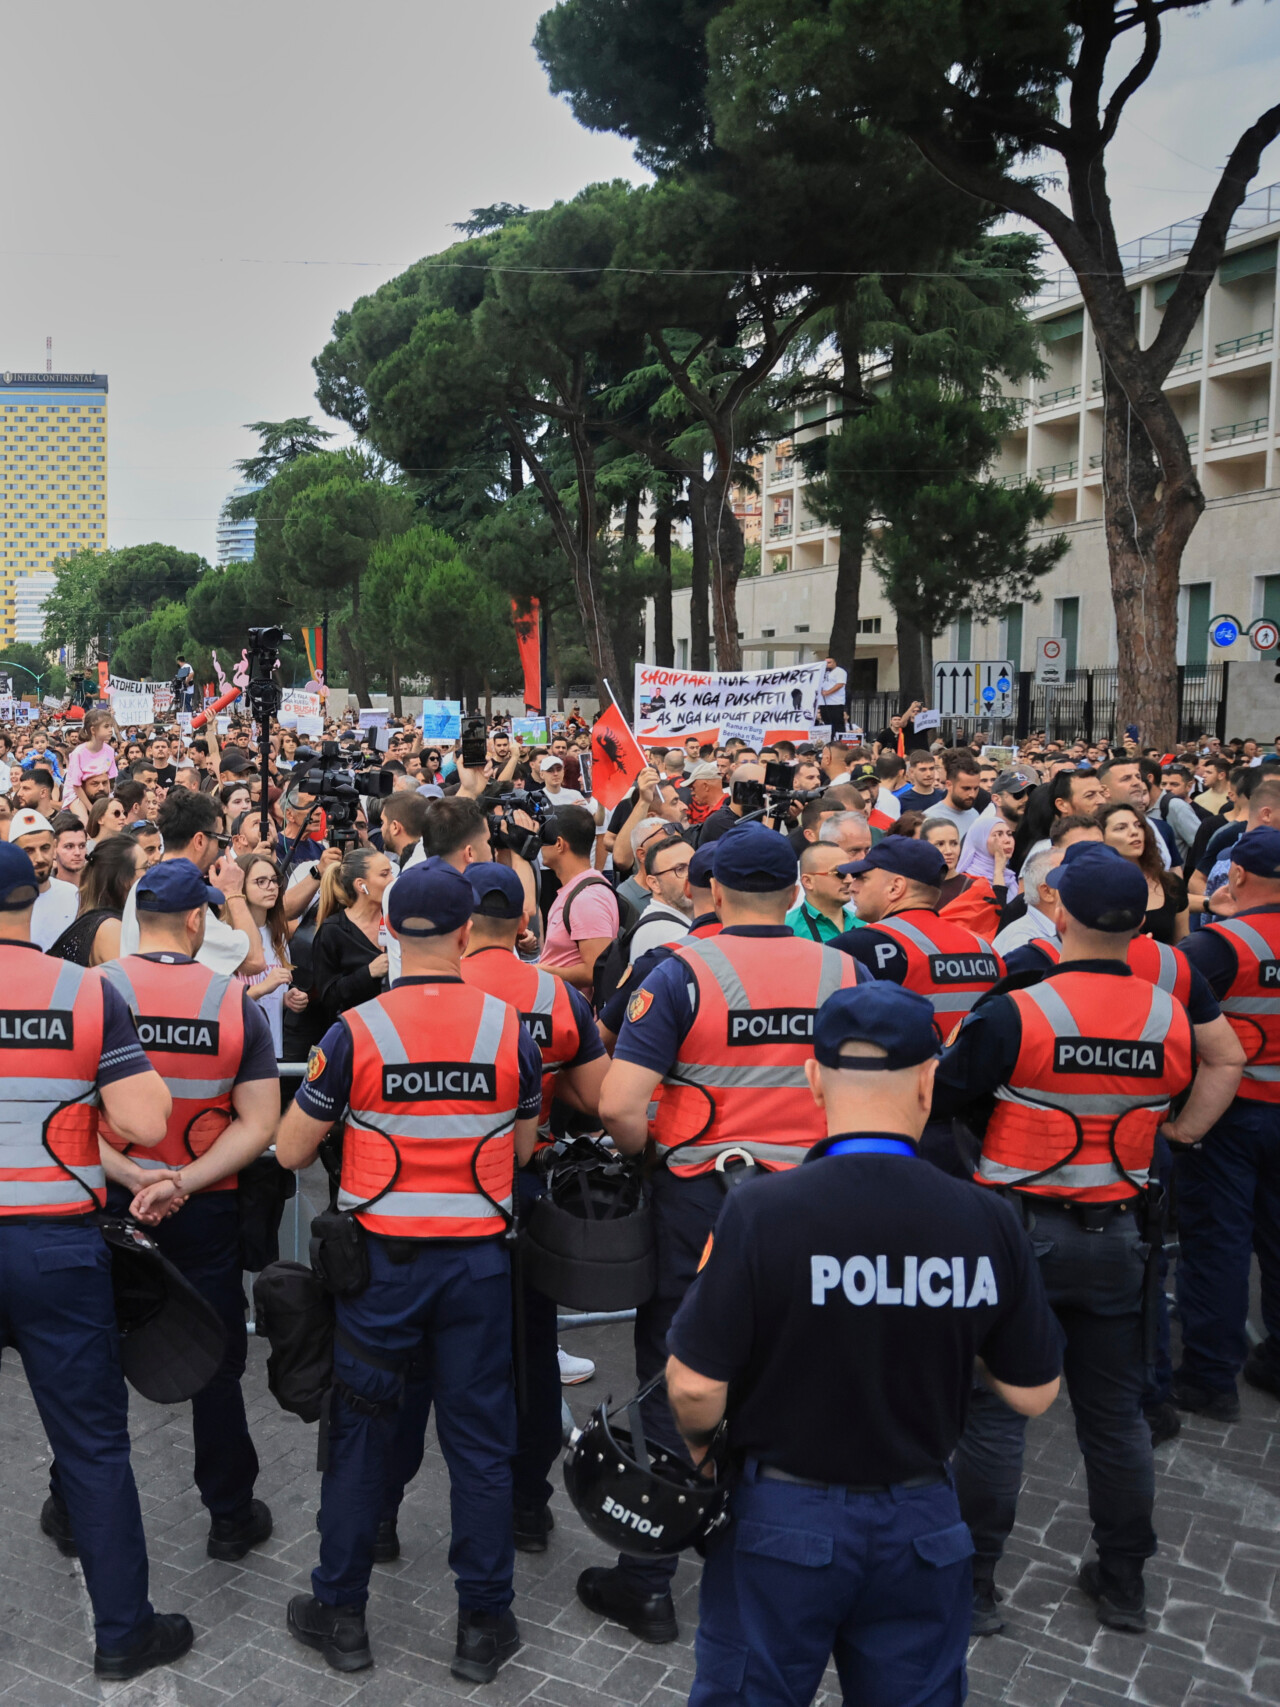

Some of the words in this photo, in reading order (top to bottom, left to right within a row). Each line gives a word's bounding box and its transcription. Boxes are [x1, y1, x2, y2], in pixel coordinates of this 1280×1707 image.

[108, 679, 142, 693] ATDHEU
[640, 669, 711, 686] SHQIPTARI
[718, 675, 750, 687] NUK
[754, 669, 819, 686] TREMBET
[669, 691, 687, 708] AS
[692, 692, 720, 707] NGA
[724, 690, 786, 707] PUSHTETI
[656, 711, 670, 726] AS
[677, 710, 702, 725] NGA
[753, 710, 804, 724] PRIVATE
[726, 722, 743, 731] Rama
[935, 959, 998, 978] POLICIA
[1058, 1045, 1157, 1070] POLICIA
[386, 1070, 490, 1094] POLICIA
[810, 1254, 999, 1308] POLICIA
[601, 1495, 665, 1539] POLICE
